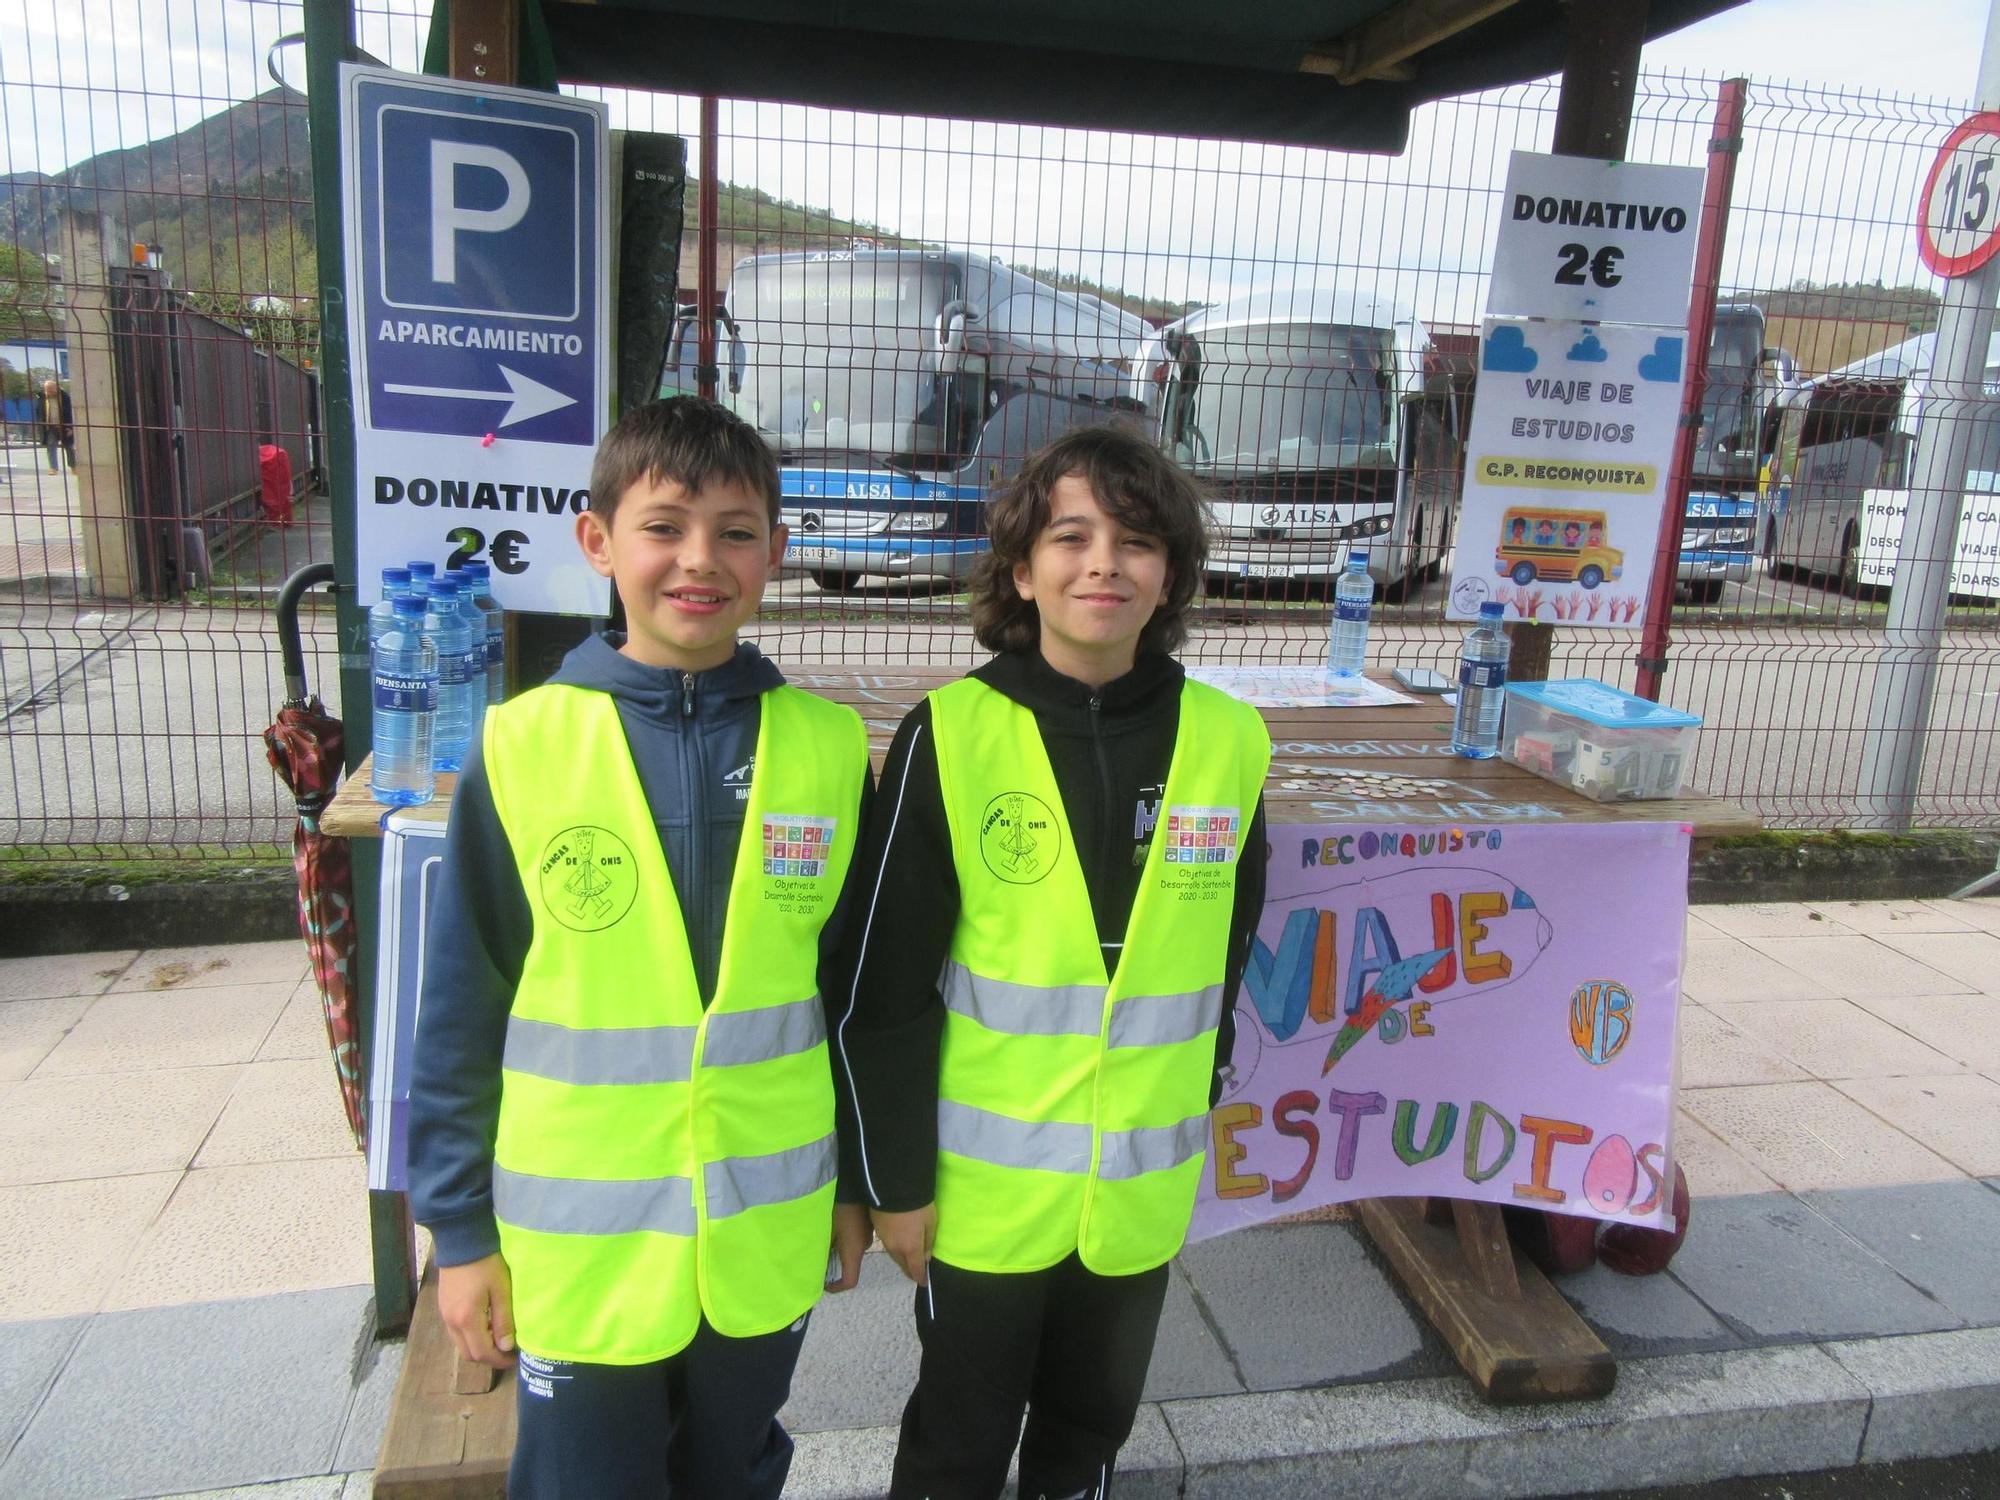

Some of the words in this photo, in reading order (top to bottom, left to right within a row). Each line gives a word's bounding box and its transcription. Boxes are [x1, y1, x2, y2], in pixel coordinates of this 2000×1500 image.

[430, 138, 532, 285] P
[1513, 194, 1687, 234] DONATIVO
[1945, 157, 1994, 234] 15
[1554, 243, 1625, 288] 2€
[378, 320, 583, 356] APARCAMIENTO
[1526, 378, 1592, 405] VIAJE
[1600, 383, 1634, 404] DE
[1511, 417, 1635, 443] ESTUDIOS
[844, 483, 894, 498] ALSA
[1486, 462, 1518, 478] C.P.
[1524, 464, 1645, 485] RECONQUISTA
[375, 476, 592, 515] DONATIVO
[1283, 509, 1342, 523] ALSA
[1961, 511, 1972, 521] A
[1976, 511, 2000, 523] CA
[445, 527, 531, 575] 2€
[375, 676, 428, 690] FUENSANTA
[543, 844, 570, 875] CANGAS
[565, 857, 578, 866] DE
[1302, 829, 1502, 868] RECONQUISTA
[1241, 892, 1513, 1042] VIAJE
[1378, 1001, 1436, 1044] DE
[1210, 1088, 1665, 1217] ESTUDIOS
